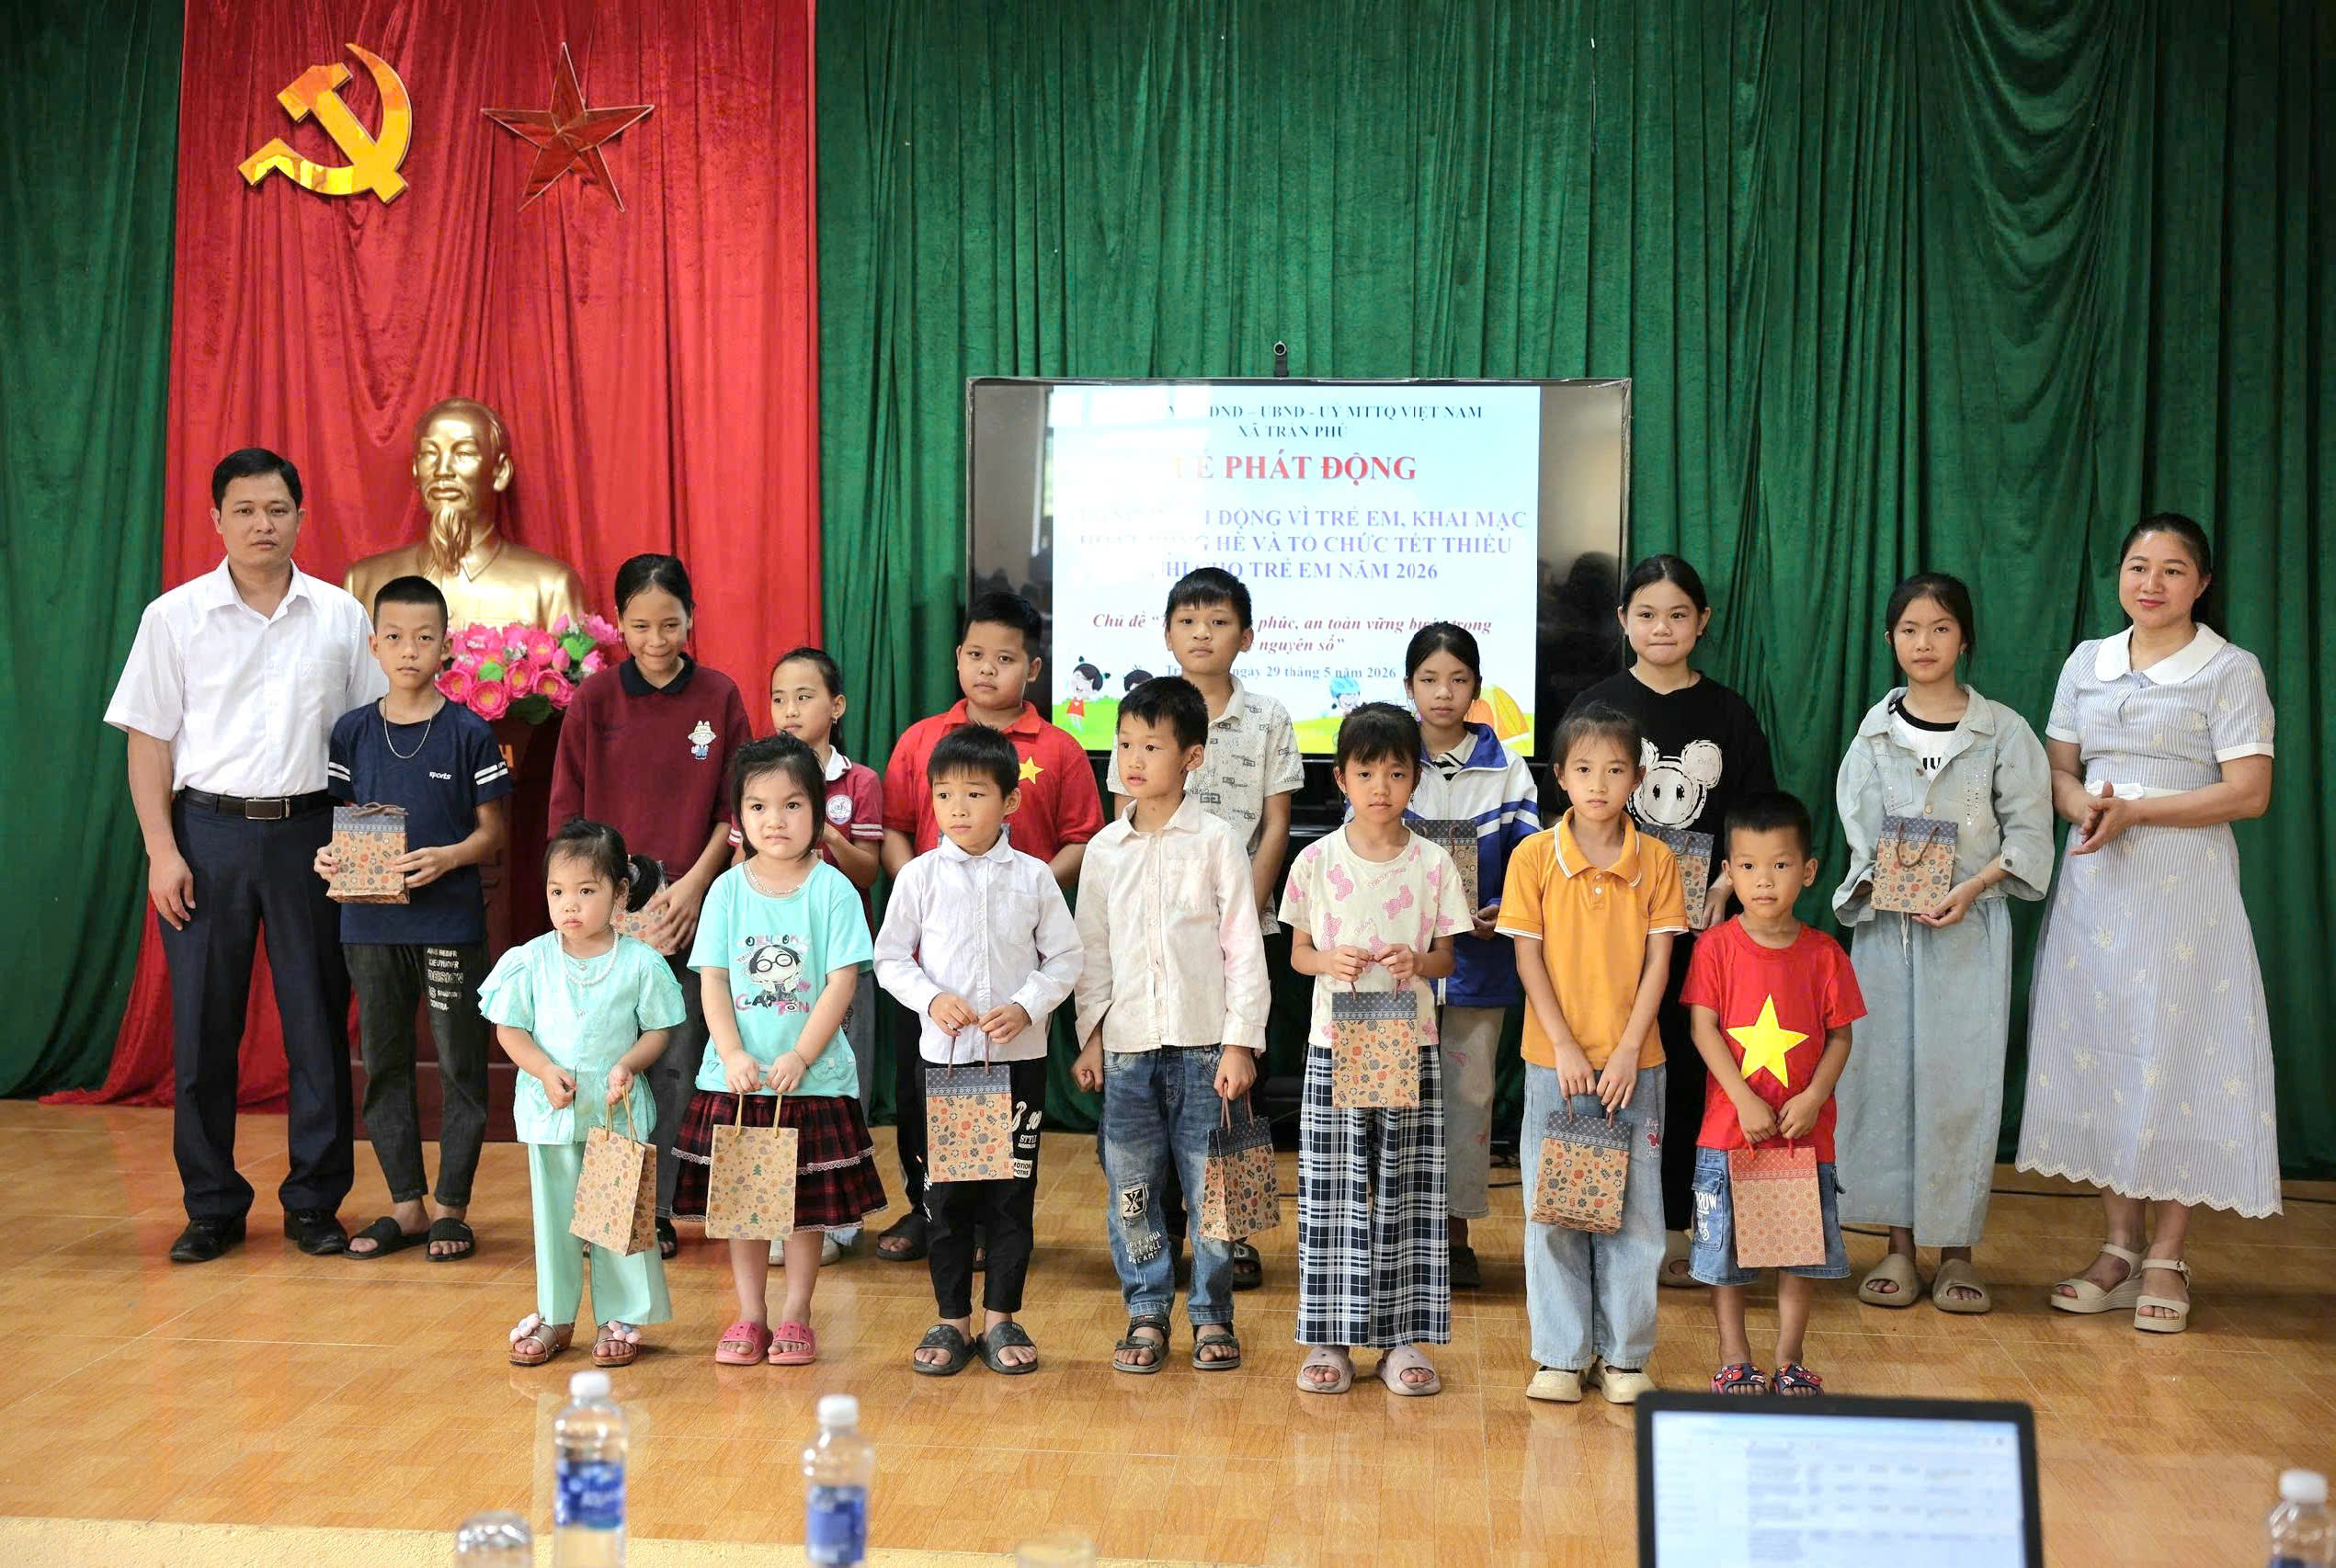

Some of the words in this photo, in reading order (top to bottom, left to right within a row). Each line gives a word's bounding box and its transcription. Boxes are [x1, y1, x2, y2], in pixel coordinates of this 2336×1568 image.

[1260, 405, 1305, 418] UBND
[1347, 405, 1396, 420] MTTQ
[1400, 403, 1440, 422] VIỆT
[1443, 405, 1483, 419] NAM
[1237, 421, 1260, 437] XÃ
[1315, 421, 1348, 437] PHÚ
[1225, 448, 1313, 480] PHÁT
[1319, 451, 1417, 486] ĐỘNG
[1287, 505, 1309, 527] VÌ
[1367, 510, 1407, 528] EM,
[1413, 510, 1469, 528] KHAI
[1476, 510, 1528, 531] MẠC
[1253, 530, 1282, 552] VÀ
[1324, 531, 1389, 553] CHỨC
[1166, 561, 1190, 577] HI
[1298, 562, 1331, 578] EM
[1339, 559, 1389, 579] NĂM
[1396, 562, 1439, 579] 2026
[1257, 615, 1299, 632] phúc,
[1304, 619, 1323, 630] an
[1328, 616, 1362, 630] toàn
[1366, 617, 1405, 634] vững
[1259, 637, 1313, 654] nguyên
[1232, 665, 1261, 679] ngày
[1266, 666, 1281, 676] 29
[1285, 665, 1320, 678] tháng
[1324, 667, 1331, 677] 5
[1367, 667, 1396, 678] 2026
